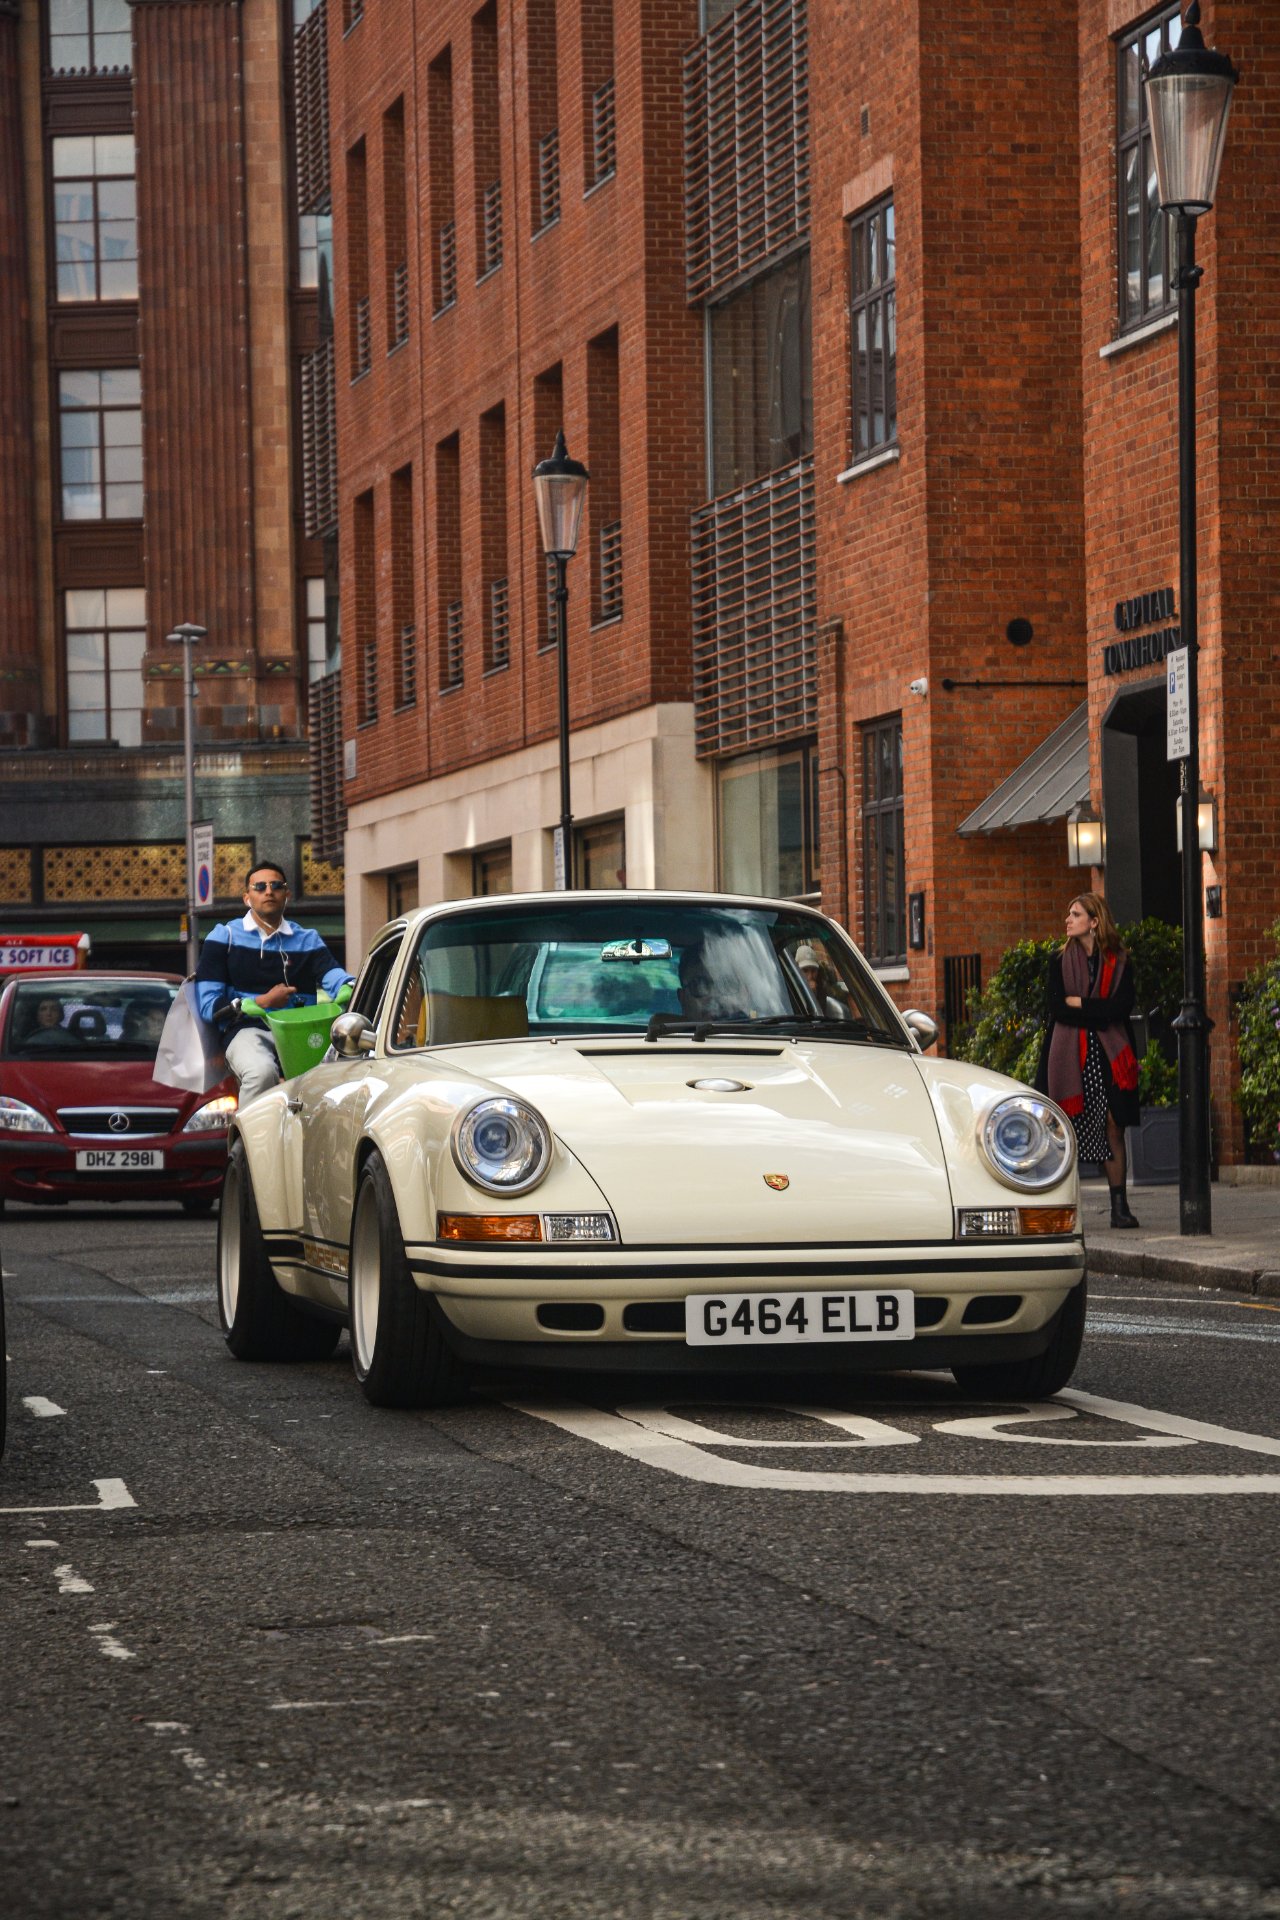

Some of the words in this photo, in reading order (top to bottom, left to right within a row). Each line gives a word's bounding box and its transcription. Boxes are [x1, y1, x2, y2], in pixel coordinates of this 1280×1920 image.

[1114, 587, 1175, 632] CAPITAL
[1102, 625, 1181, 675] TOWNHOUS
[9, 949, 44, 964] SOFT
[48, 949, 70, 964] ICE
[86, 1151, 116, 1167] DHZ
[120, 1151, 154, 1167] 2981
[703, 1296, 809, 1337] G464
[821, 1294, 900, 1333] ELB
